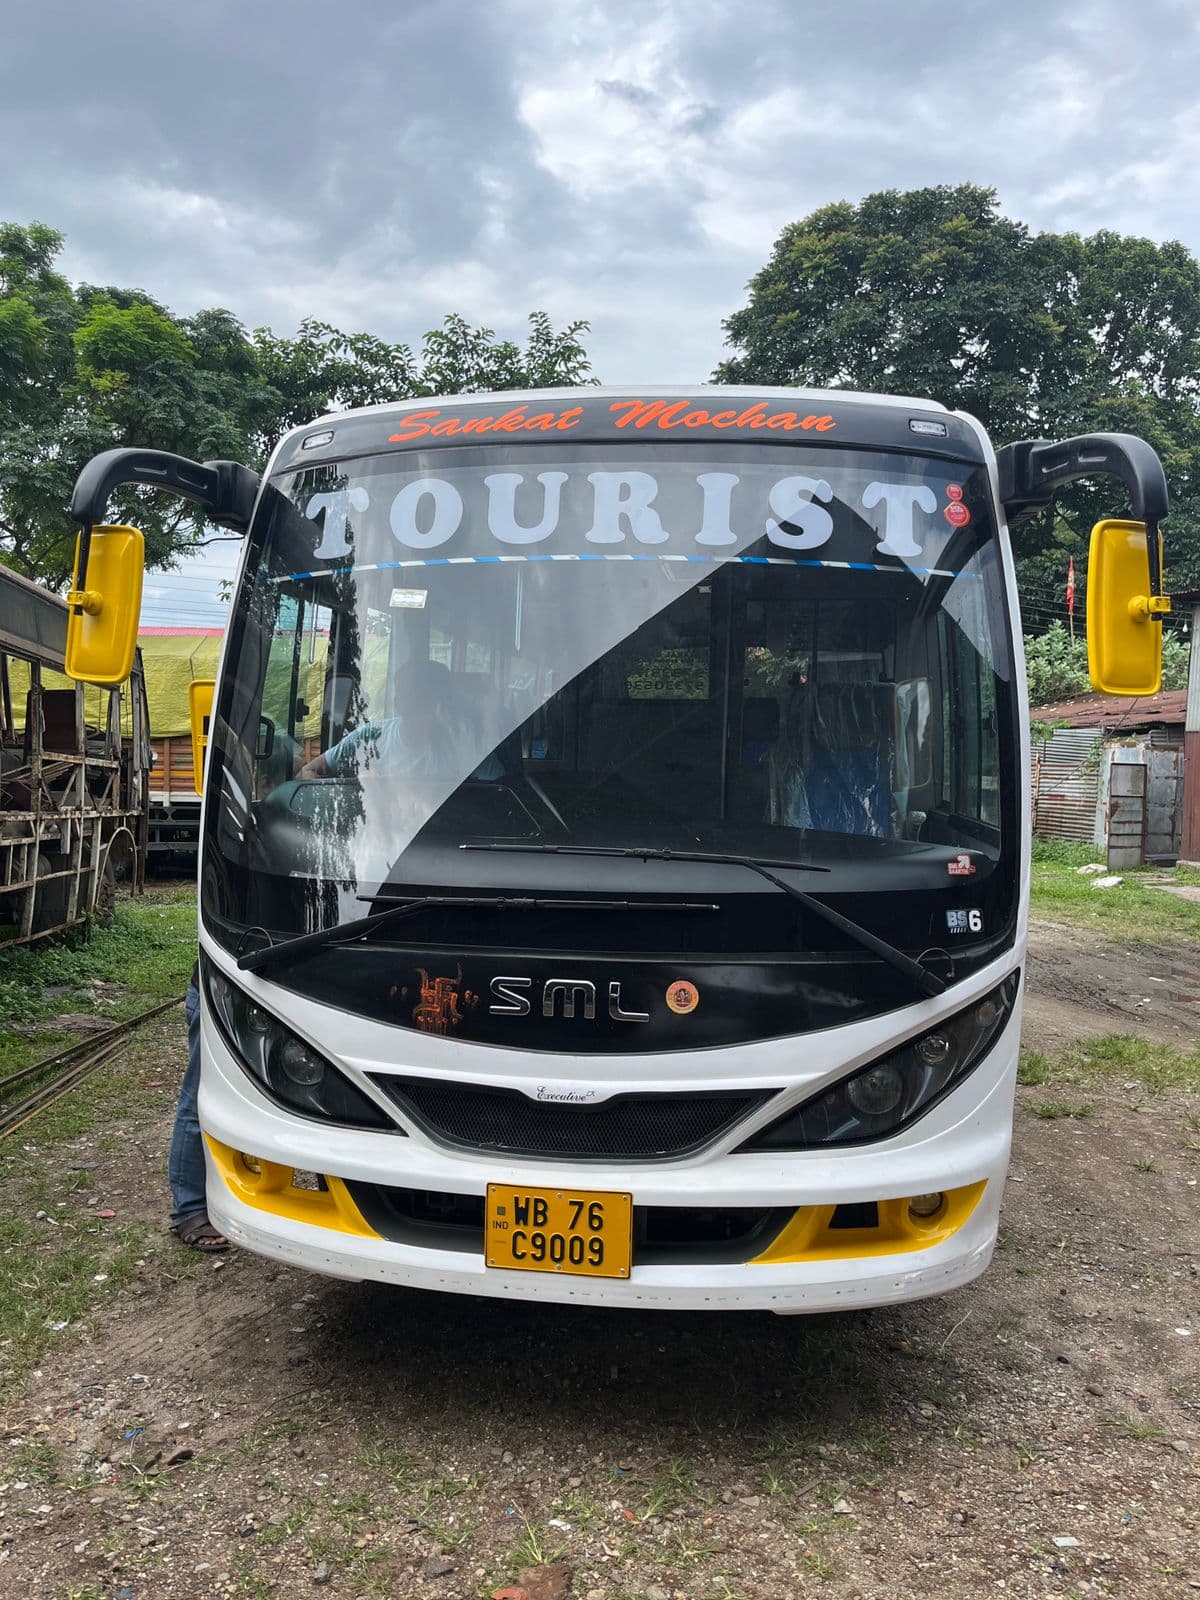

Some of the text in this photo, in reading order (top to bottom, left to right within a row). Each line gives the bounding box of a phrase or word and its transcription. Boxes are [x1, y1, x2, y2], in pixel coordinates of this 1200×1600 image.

[388, 399, 837, 442] Sankat Mochan
[305, 471, 937, 560] TOURIST
[489, 976, 650, 1023] SML
[537, 1086, 586, 1101] Executive
[492, 1220, 509, 1230] IND
[514, 1196, 604, 1231] WB 76
[511, 1231, 604, 1266] C9009
